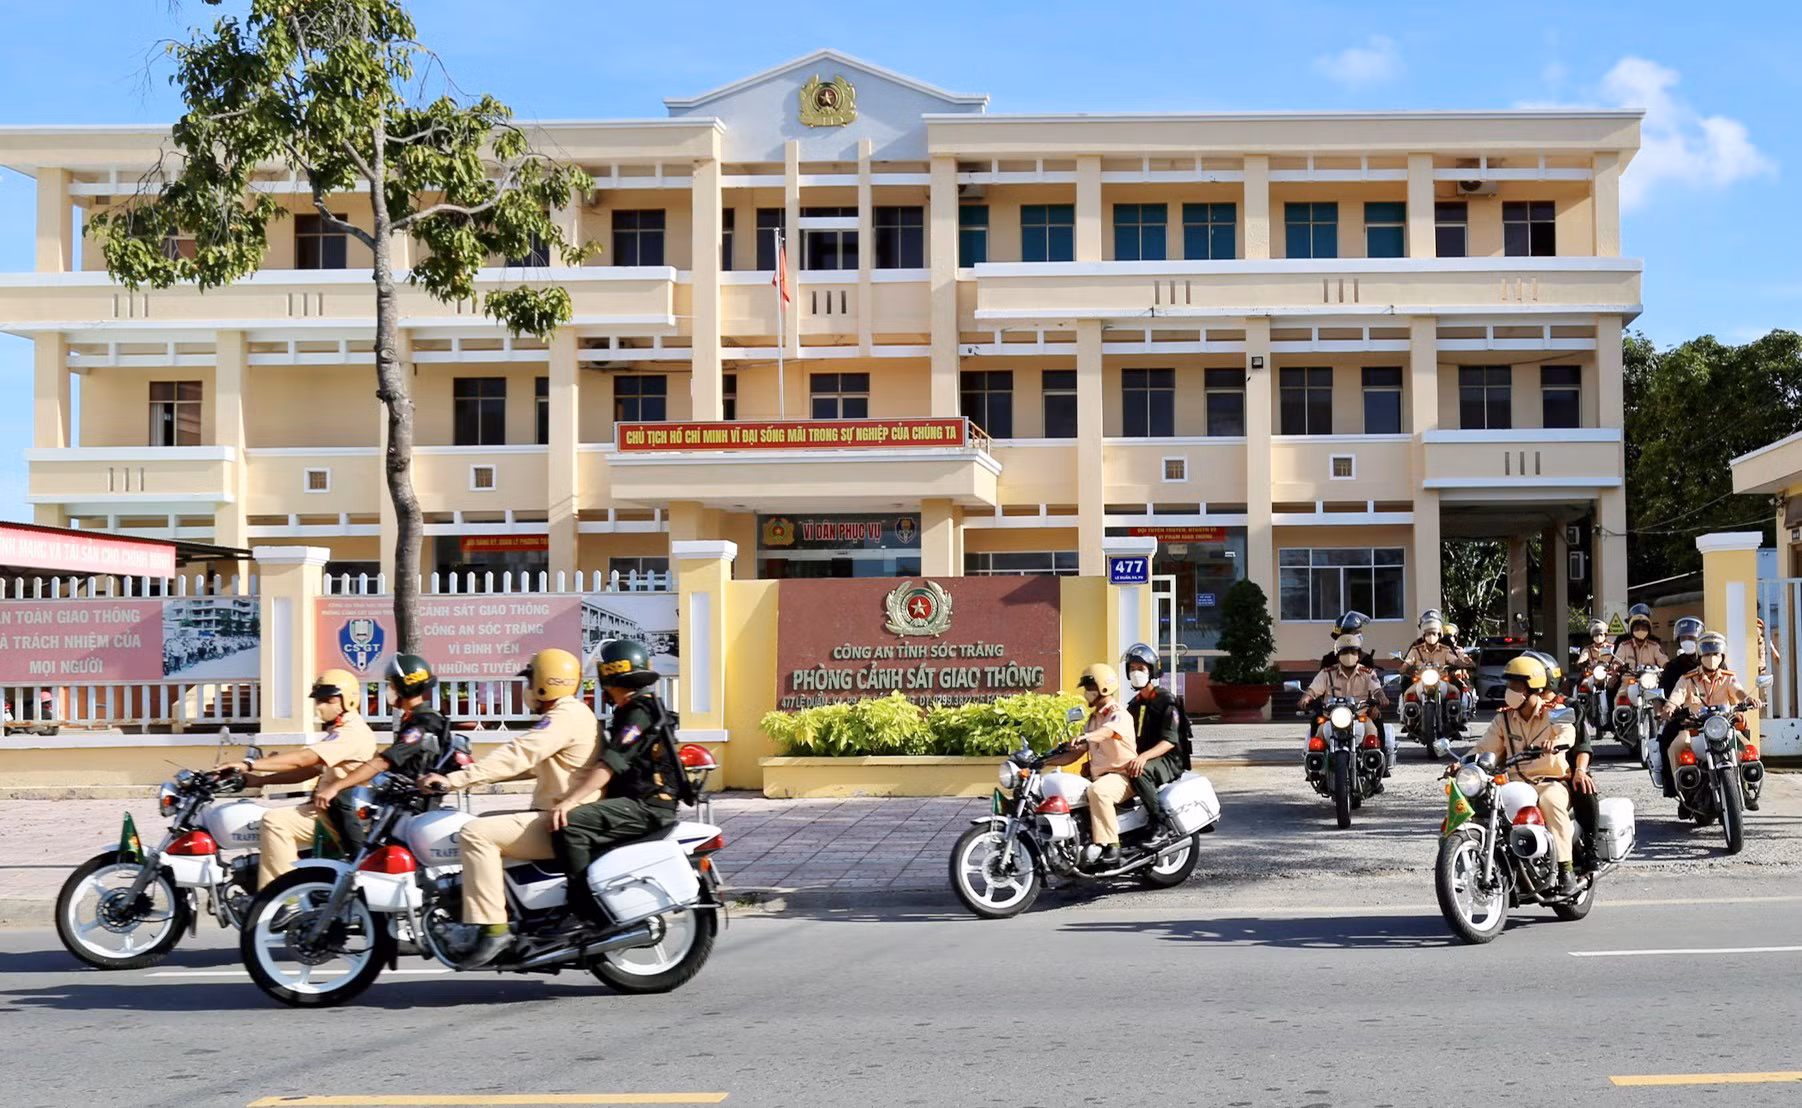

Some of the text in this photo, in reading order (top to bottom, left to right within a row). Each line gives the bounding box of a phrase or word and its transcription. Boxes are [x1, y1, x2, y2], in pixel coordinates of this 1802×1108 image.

[626, 421, 957, 447] CHỦ TỊCH HỒ CHÍ MINH VĨ ĐẠI SỐNG MÃI TRONG SỰ NGHIỆP CỦA CHÚNG TA
[815, 520, 836, 540] DÂN
[838, 522, 865, 543] PHỤC
[1115, 560, 1143, 573] 477
[0, 606, 141, 624] N TOÀN GIAO THÔNG
[419, 602, 549, 616] CẢNH SÁT GIAO THÔNG
[424, 621, 544, 636] CÔNG AN SÓC TRĂNG
[0, 629, 141, 651] À TRÁCH NHIỆM CỦA
[344, 643, 380, 652] CSGT
[448, 642, 519, 655] VÌ BÌNH YÊN
[833, 640, 1005, 659] CÔNG AN TỈNH SÓC TRĂNG
[29, 656, 104, 676] MỌI NGƯỜI
[438, 661, 479, 673] NHỮNG
[481, 658, 521, 673] TUYẾN
[792, 660, 1045, 690] PHÒNG CẢNH SÁT GIAO THÔNG
[781, 696, 796, 709] 477
[796, 693, 806, 708] LÊ
[807, 691, 828, 707] DUẨN
[231, 832, 260, 841] TRAFFI
[429, 847, 460, 857] TRAFF
